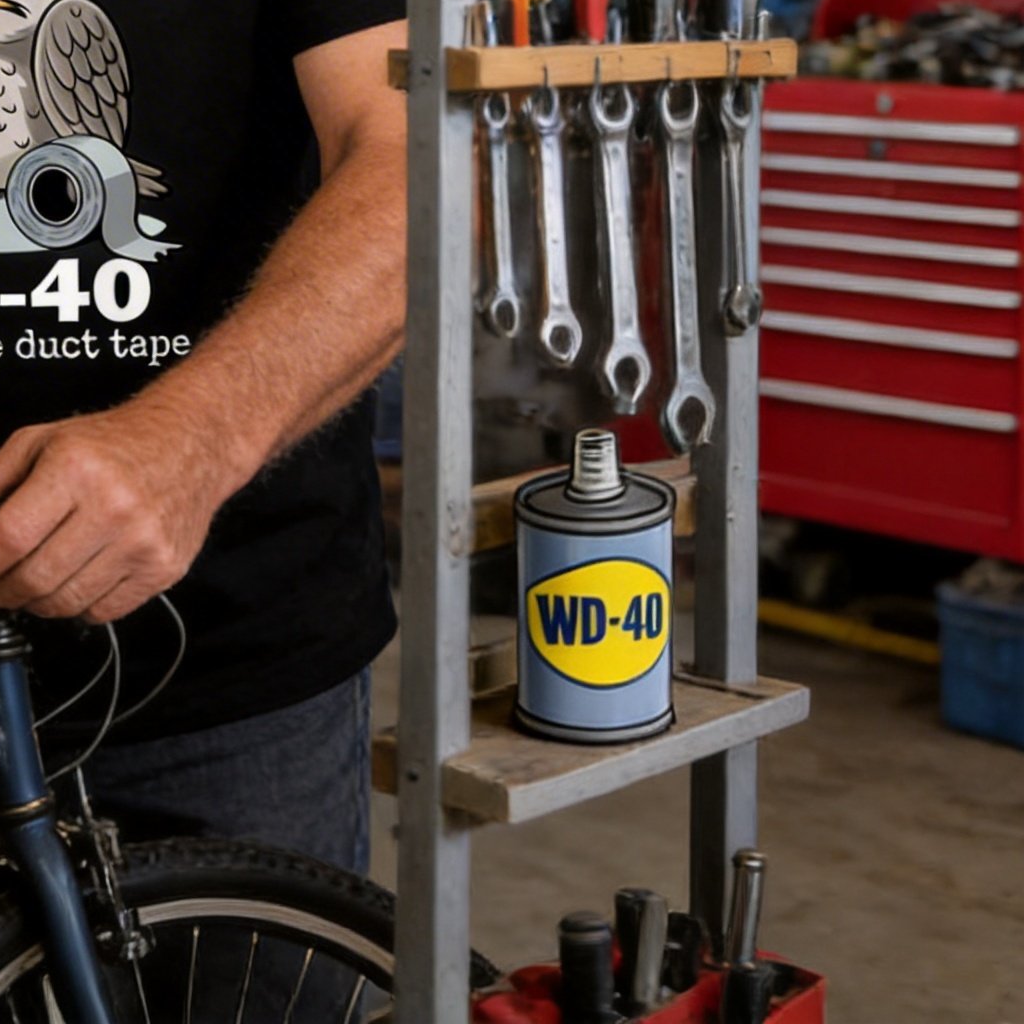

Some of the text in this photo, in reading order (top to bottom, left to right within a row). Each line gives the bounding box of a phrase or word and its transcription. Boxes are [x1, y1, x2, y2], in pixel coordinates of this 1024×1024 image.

[15, 329, 99, 359] duct
[108, 329, 191, 366] tape
[535, 592, 664, 646] WD-40
